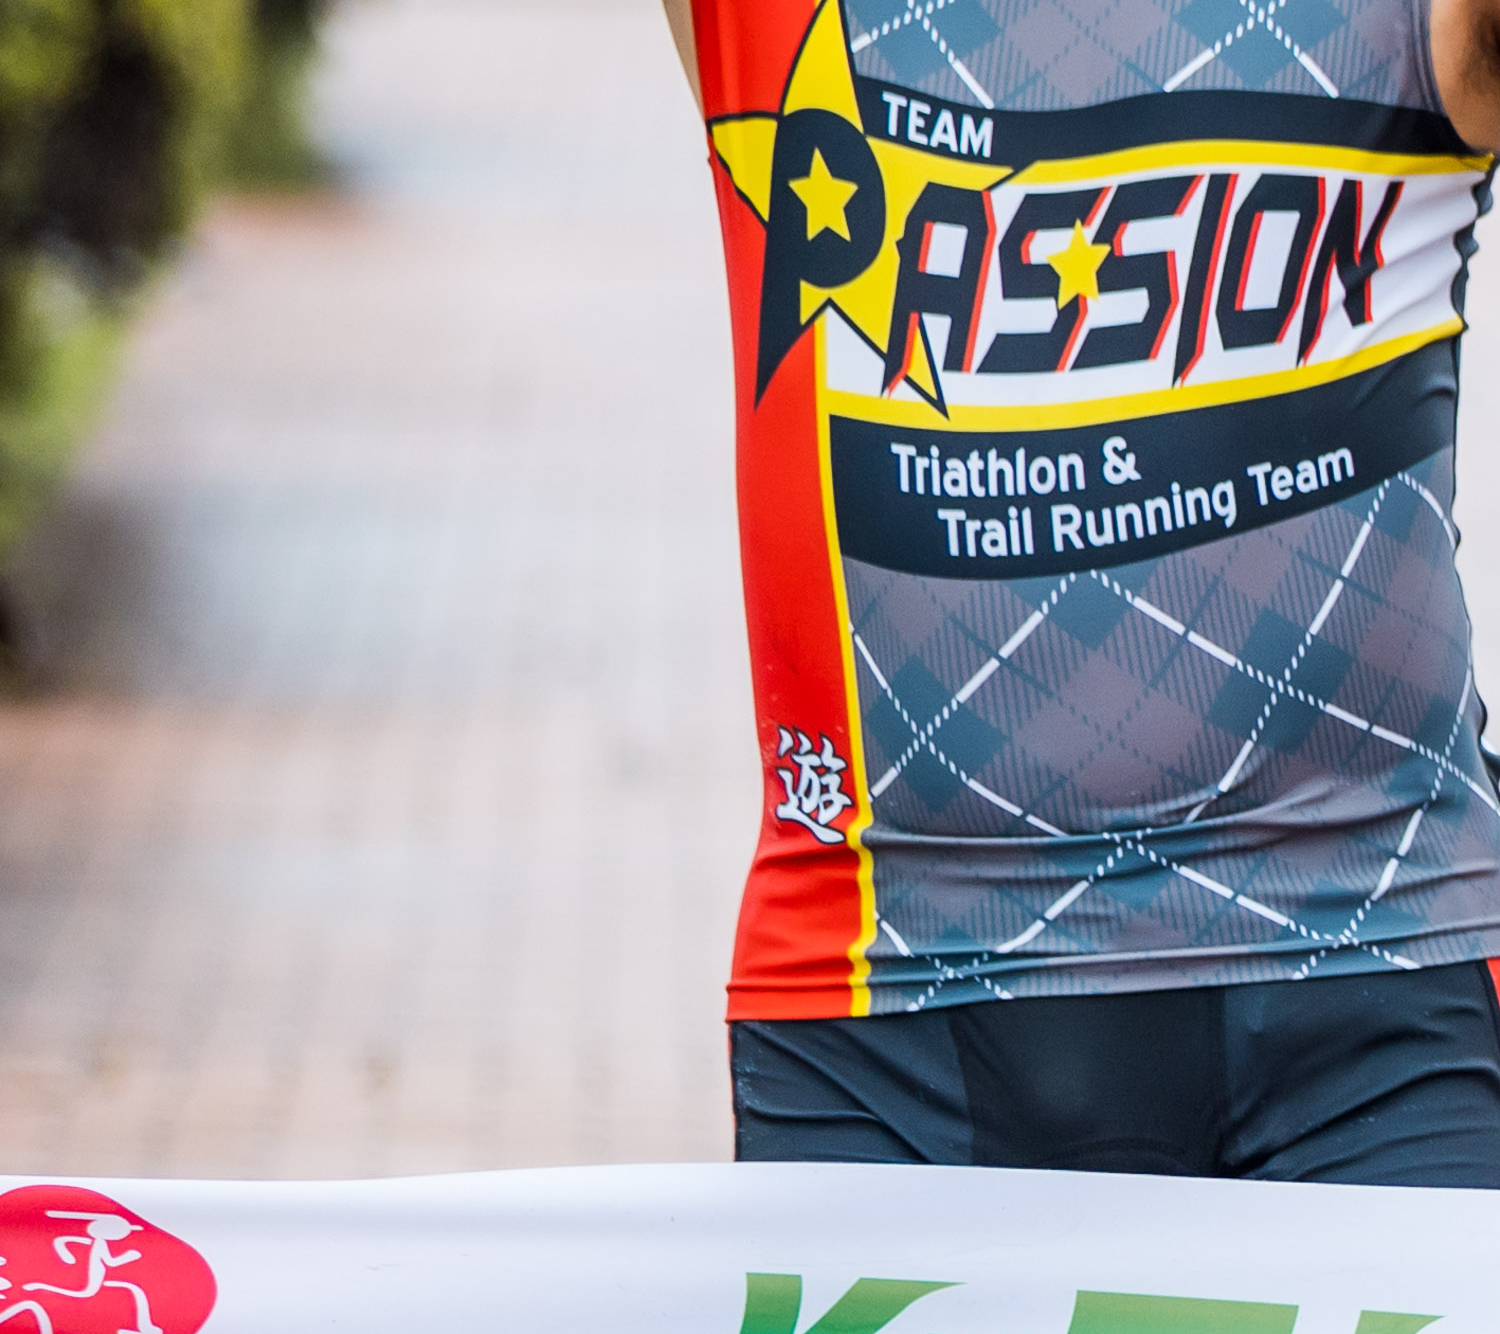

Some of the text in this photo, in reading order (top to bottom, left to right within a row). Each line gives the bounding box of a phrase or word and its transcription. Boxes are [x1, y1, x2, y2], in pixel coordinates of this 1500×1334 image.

[882, 91, 995, 159] TEAM
[755, 107, 1404, 411] PASSION
[891, 435, 1142, 498] Triathlon &
[937, 446, 1356, 559] Trail Running Team
[776, 724, 854, 845] 遊
